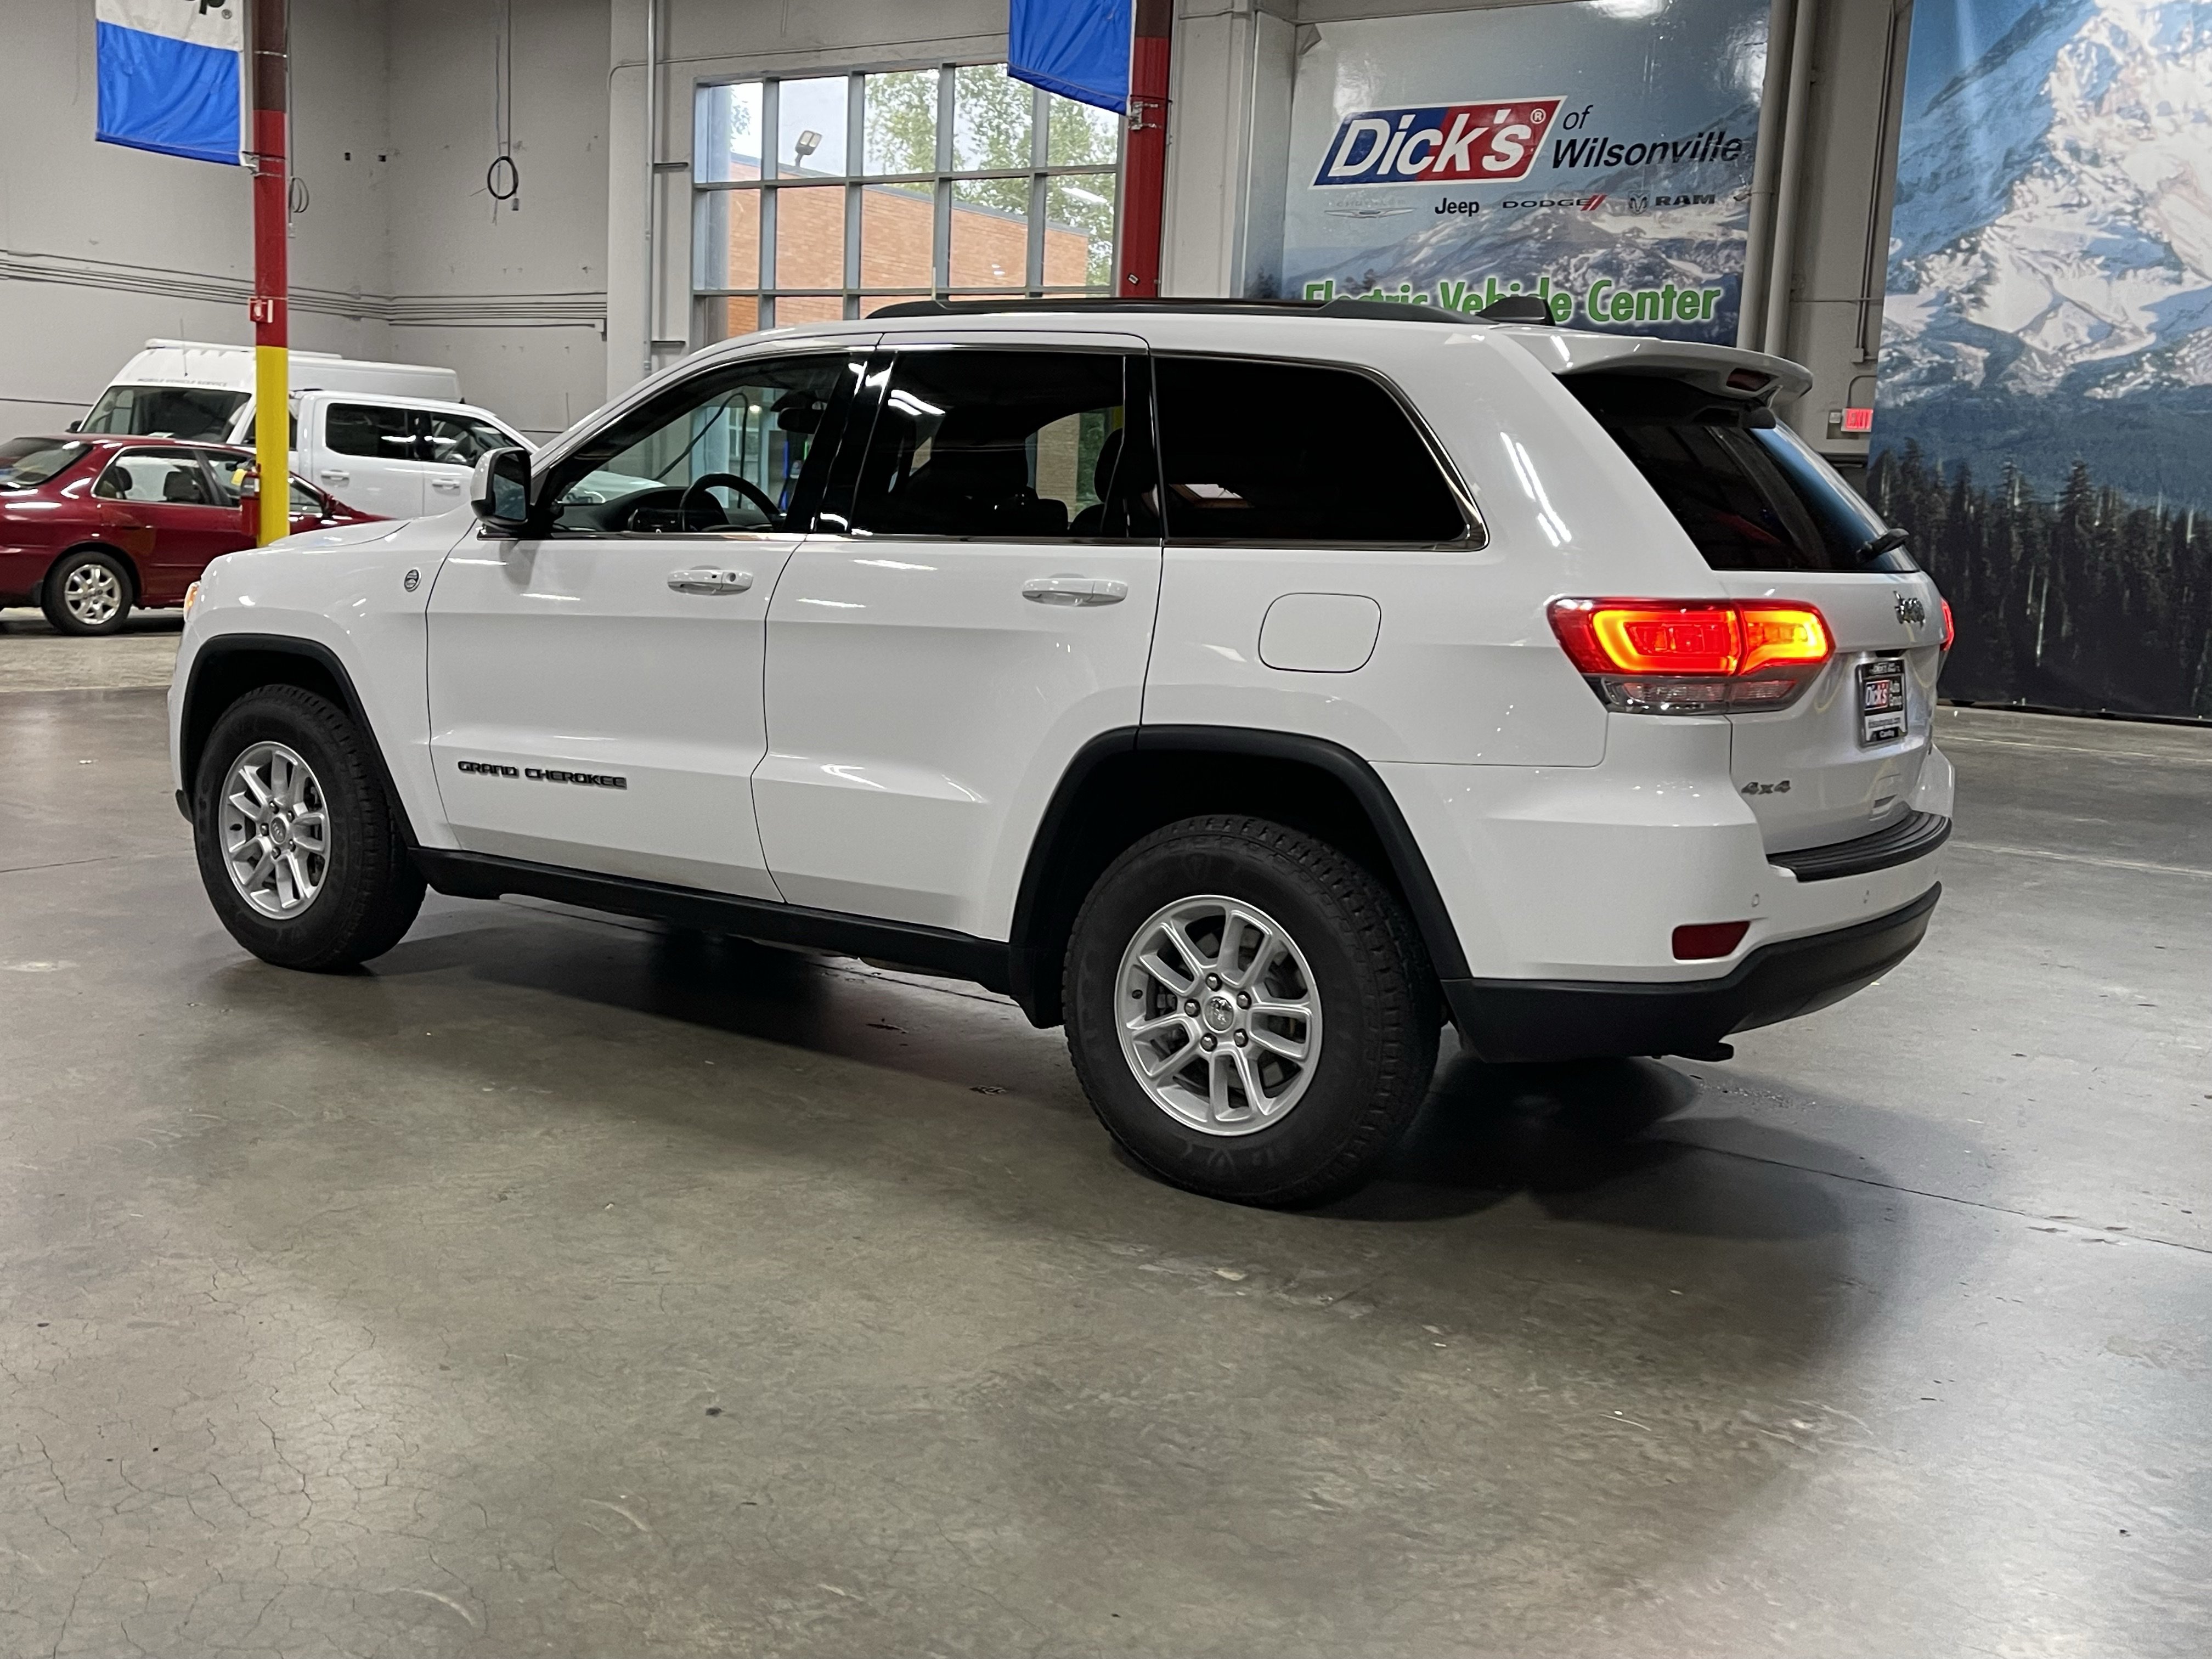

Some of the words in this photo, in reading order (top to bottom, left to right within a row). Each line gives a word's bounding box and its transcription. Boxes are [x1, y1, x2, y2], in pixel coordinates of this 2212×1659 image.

[1562, 104, 1593, 130] of
[1552, 131, 1742, 169] Wilsonville
[1435, 198, 1480, 217] Jeep
[1503, 199, 1591, 209] DODGE
[1655, 194, 1716, 206] RAM
[1588, 279, 1721, 322] Center
[458, 761, 519, 778] GRAND
[524, 768, 627, 789] CHEROKEE
